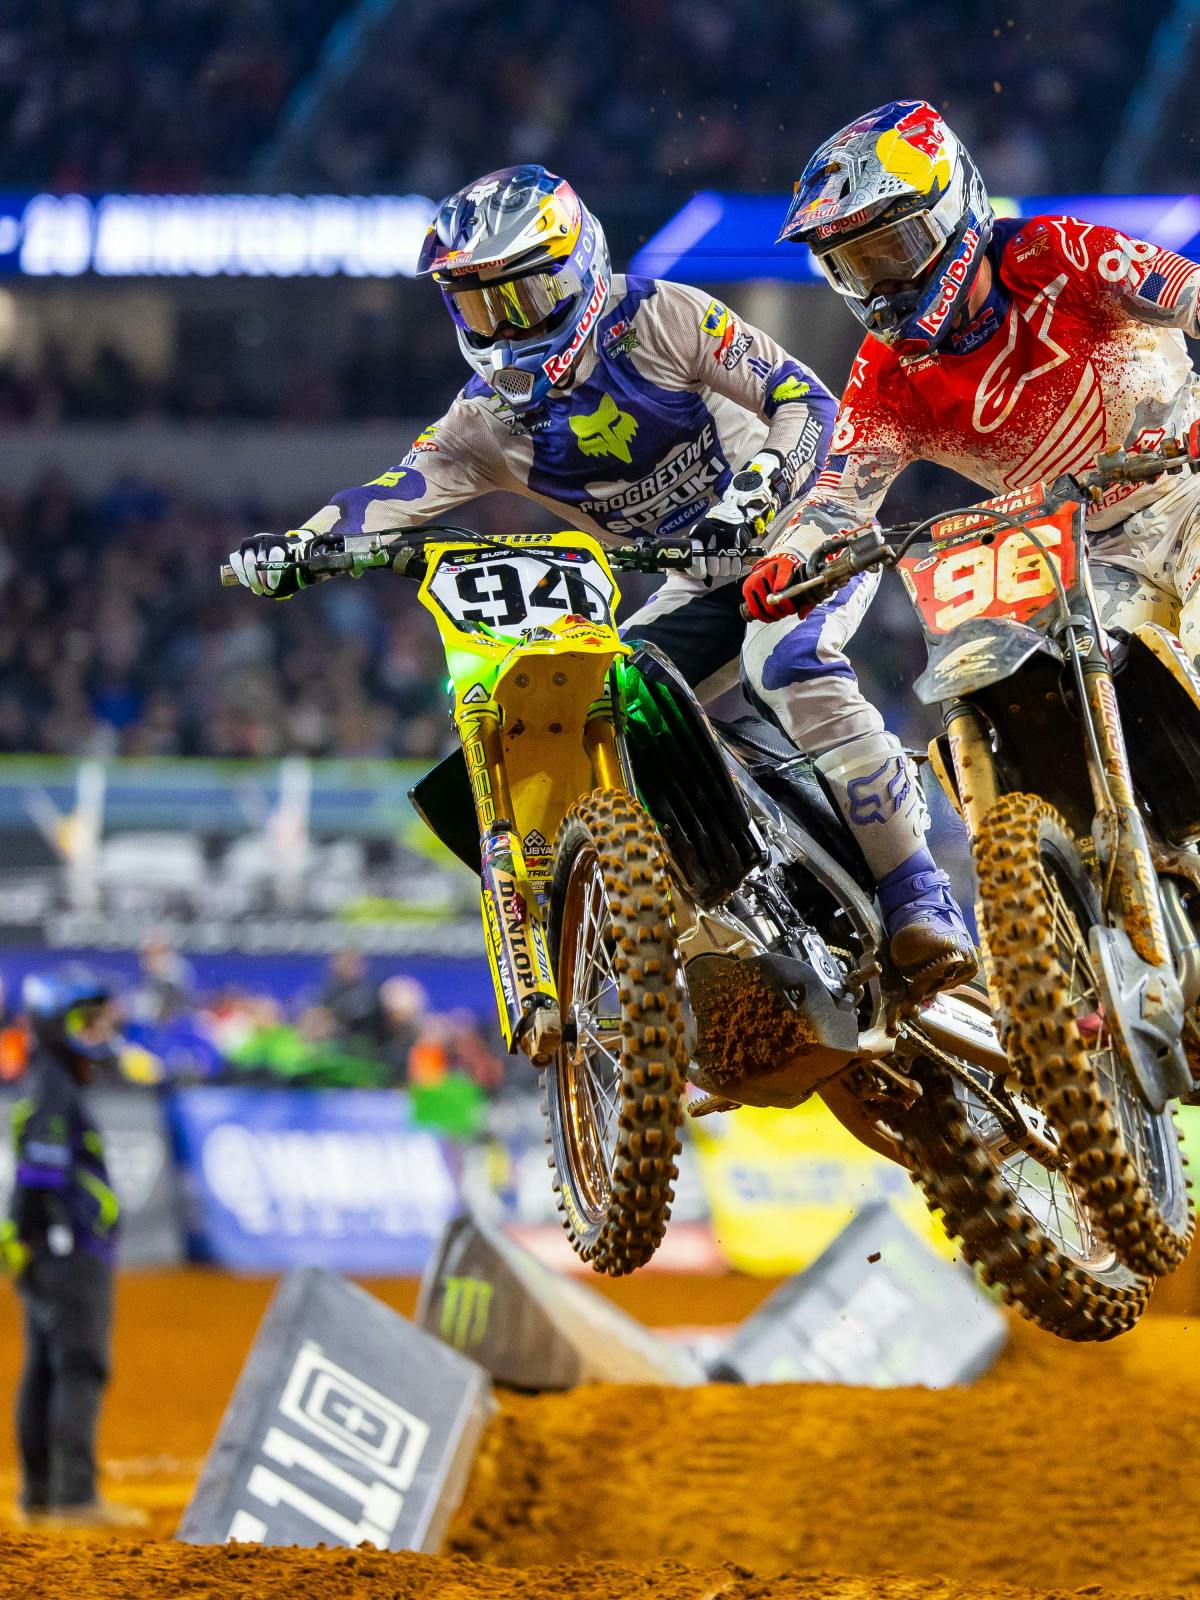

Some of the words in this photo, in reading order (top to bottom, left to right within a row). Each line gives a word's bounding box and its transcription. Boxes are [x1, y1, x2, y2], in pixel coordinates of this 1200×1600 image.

[574, 220, 596, 271] FOX
[815, 220, 841, 240] Red
[839, 207, 868, 229] Bull
[917, 275, 959, 337] Red
[948, 227, 981, 288] Bull
[1098, 233, 1161, 289] 96
[544, 327, 582, 383] Red
[576, 274, 607, 336] Bull
[607, 456, 725, 534] SUZUKI
[659, 512, 683, 535] CYCLE
[681, 499, 707, 522] GEAR
[656, 548, 690, 559] ASV
[717, 548, 747, 557] ASV
[934, 525, 1062, 632] 96
[455, 563, 598, 628] 94
[498, 880, 535, 989] DUNLOP
